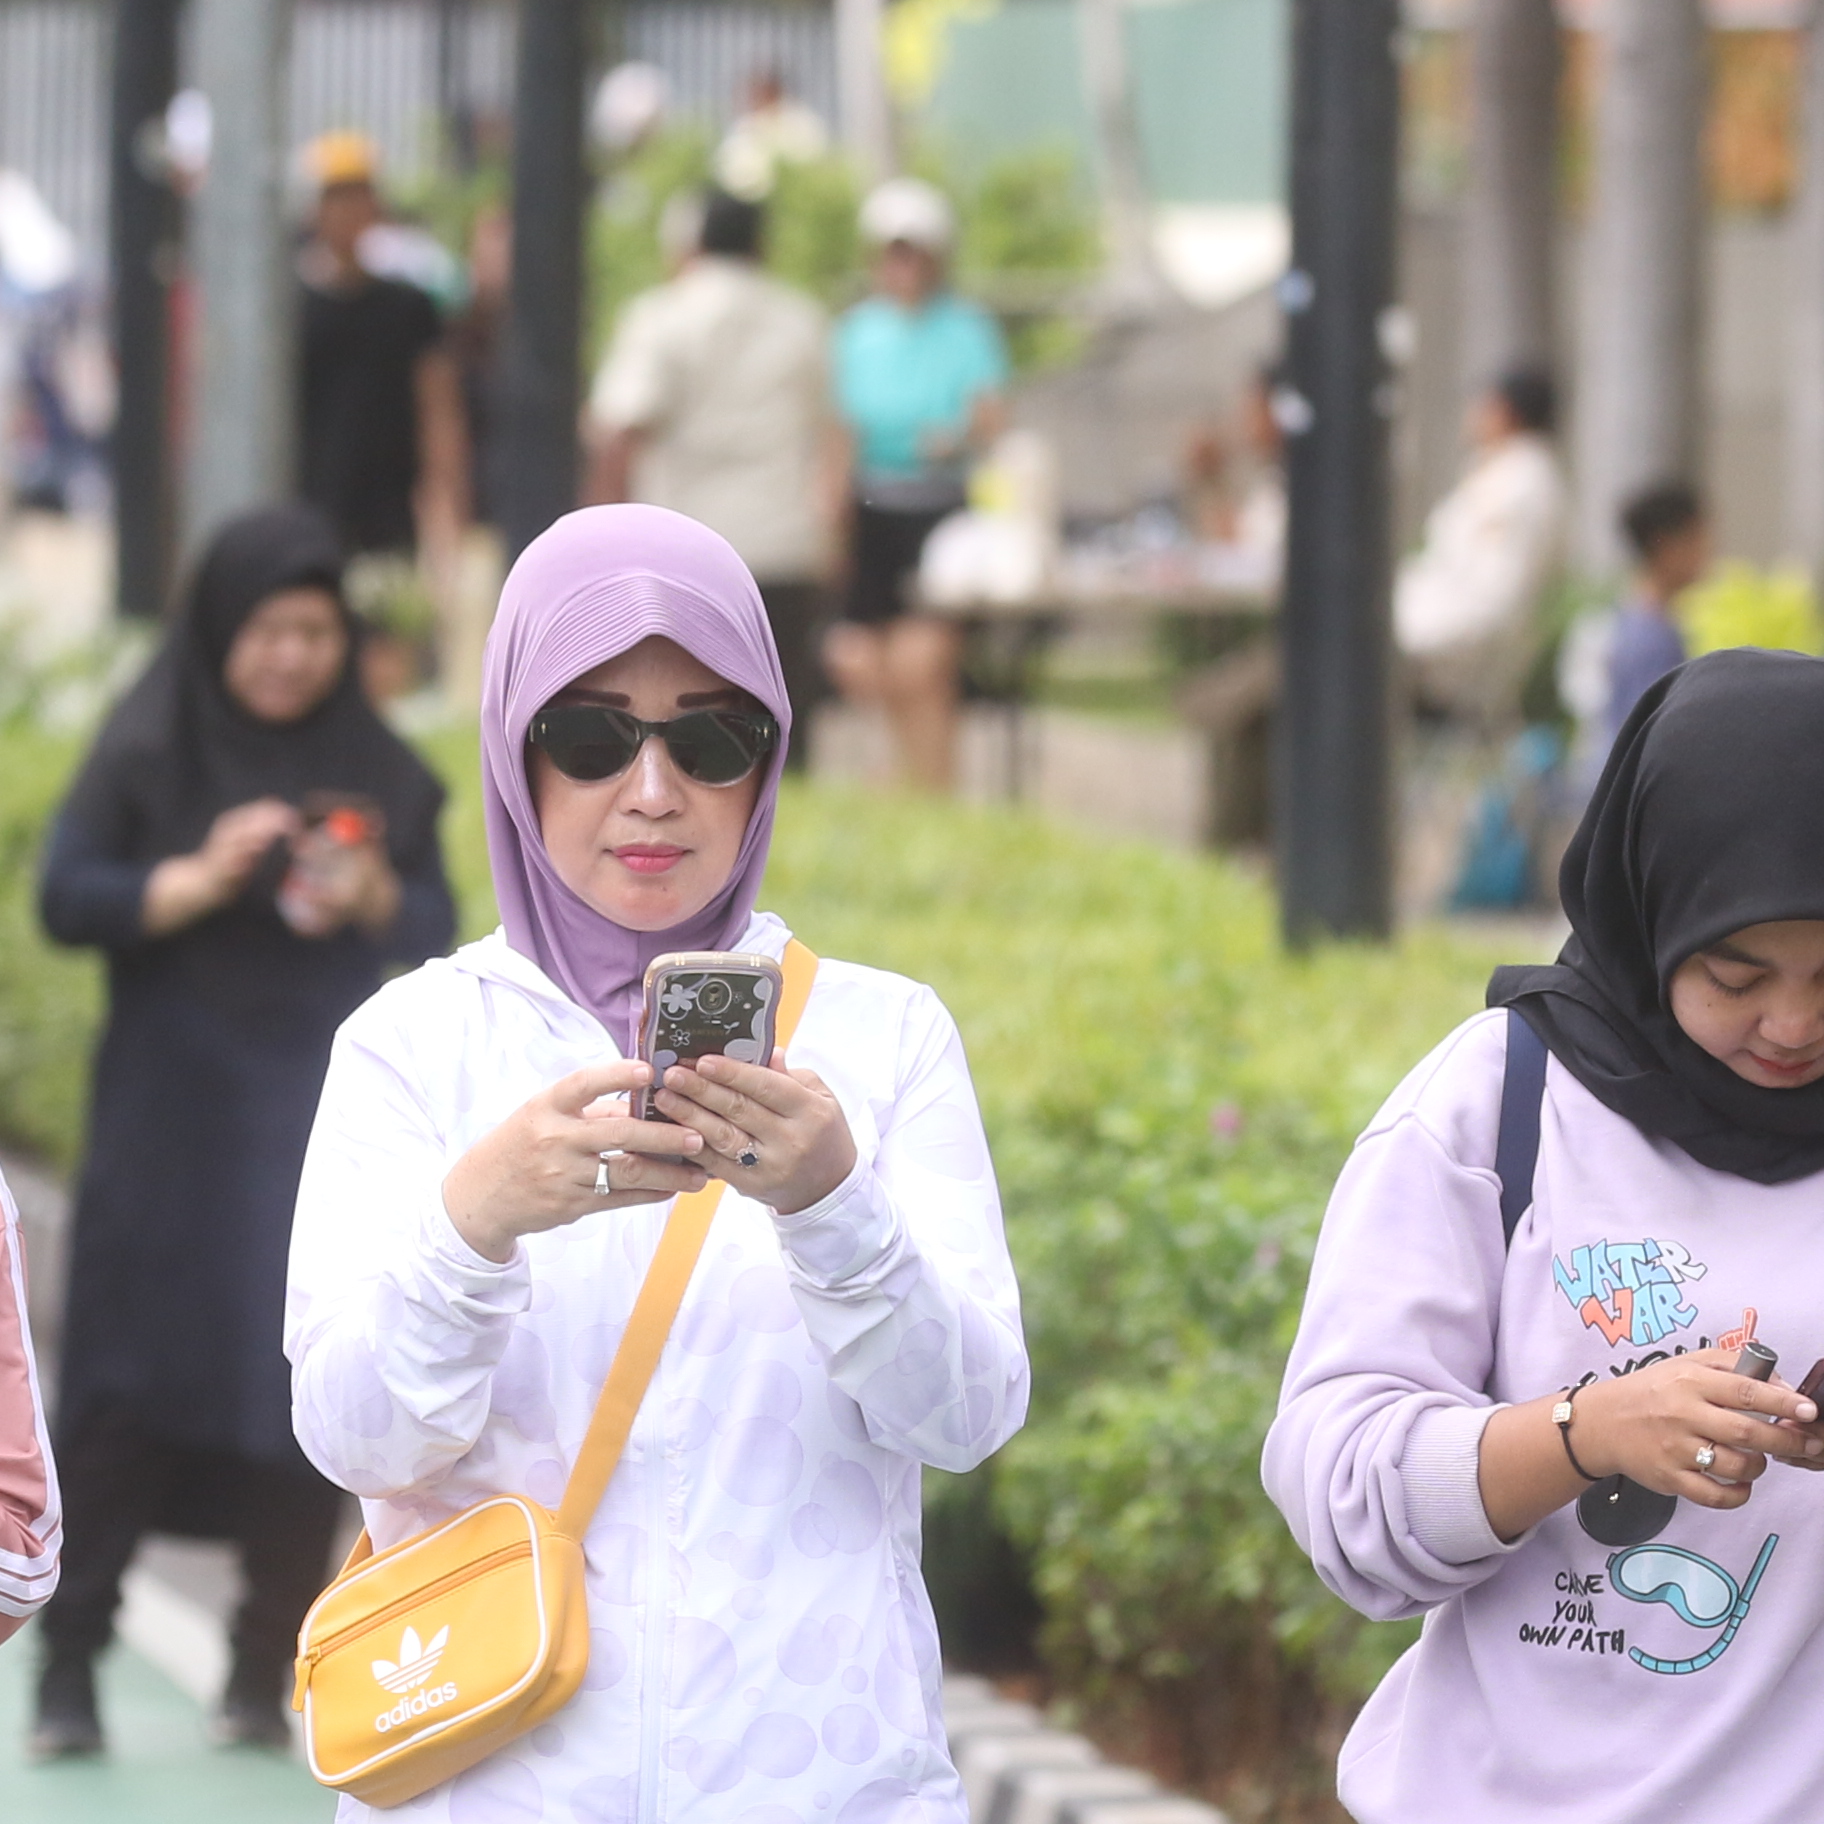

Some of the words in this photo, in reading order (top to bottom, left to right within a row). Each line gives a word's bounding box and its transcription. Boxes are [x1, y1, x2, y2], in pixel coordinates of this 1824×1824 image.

[1551, 1237, 1708, 1310] WATER
[1579, 1282, 1698, 1348] WAR
[1519, 1623, 1567, 1647] OWN
[1566, 1628, 1626, 1655] PATH
[375, 1681, 458, 1734] adidas
